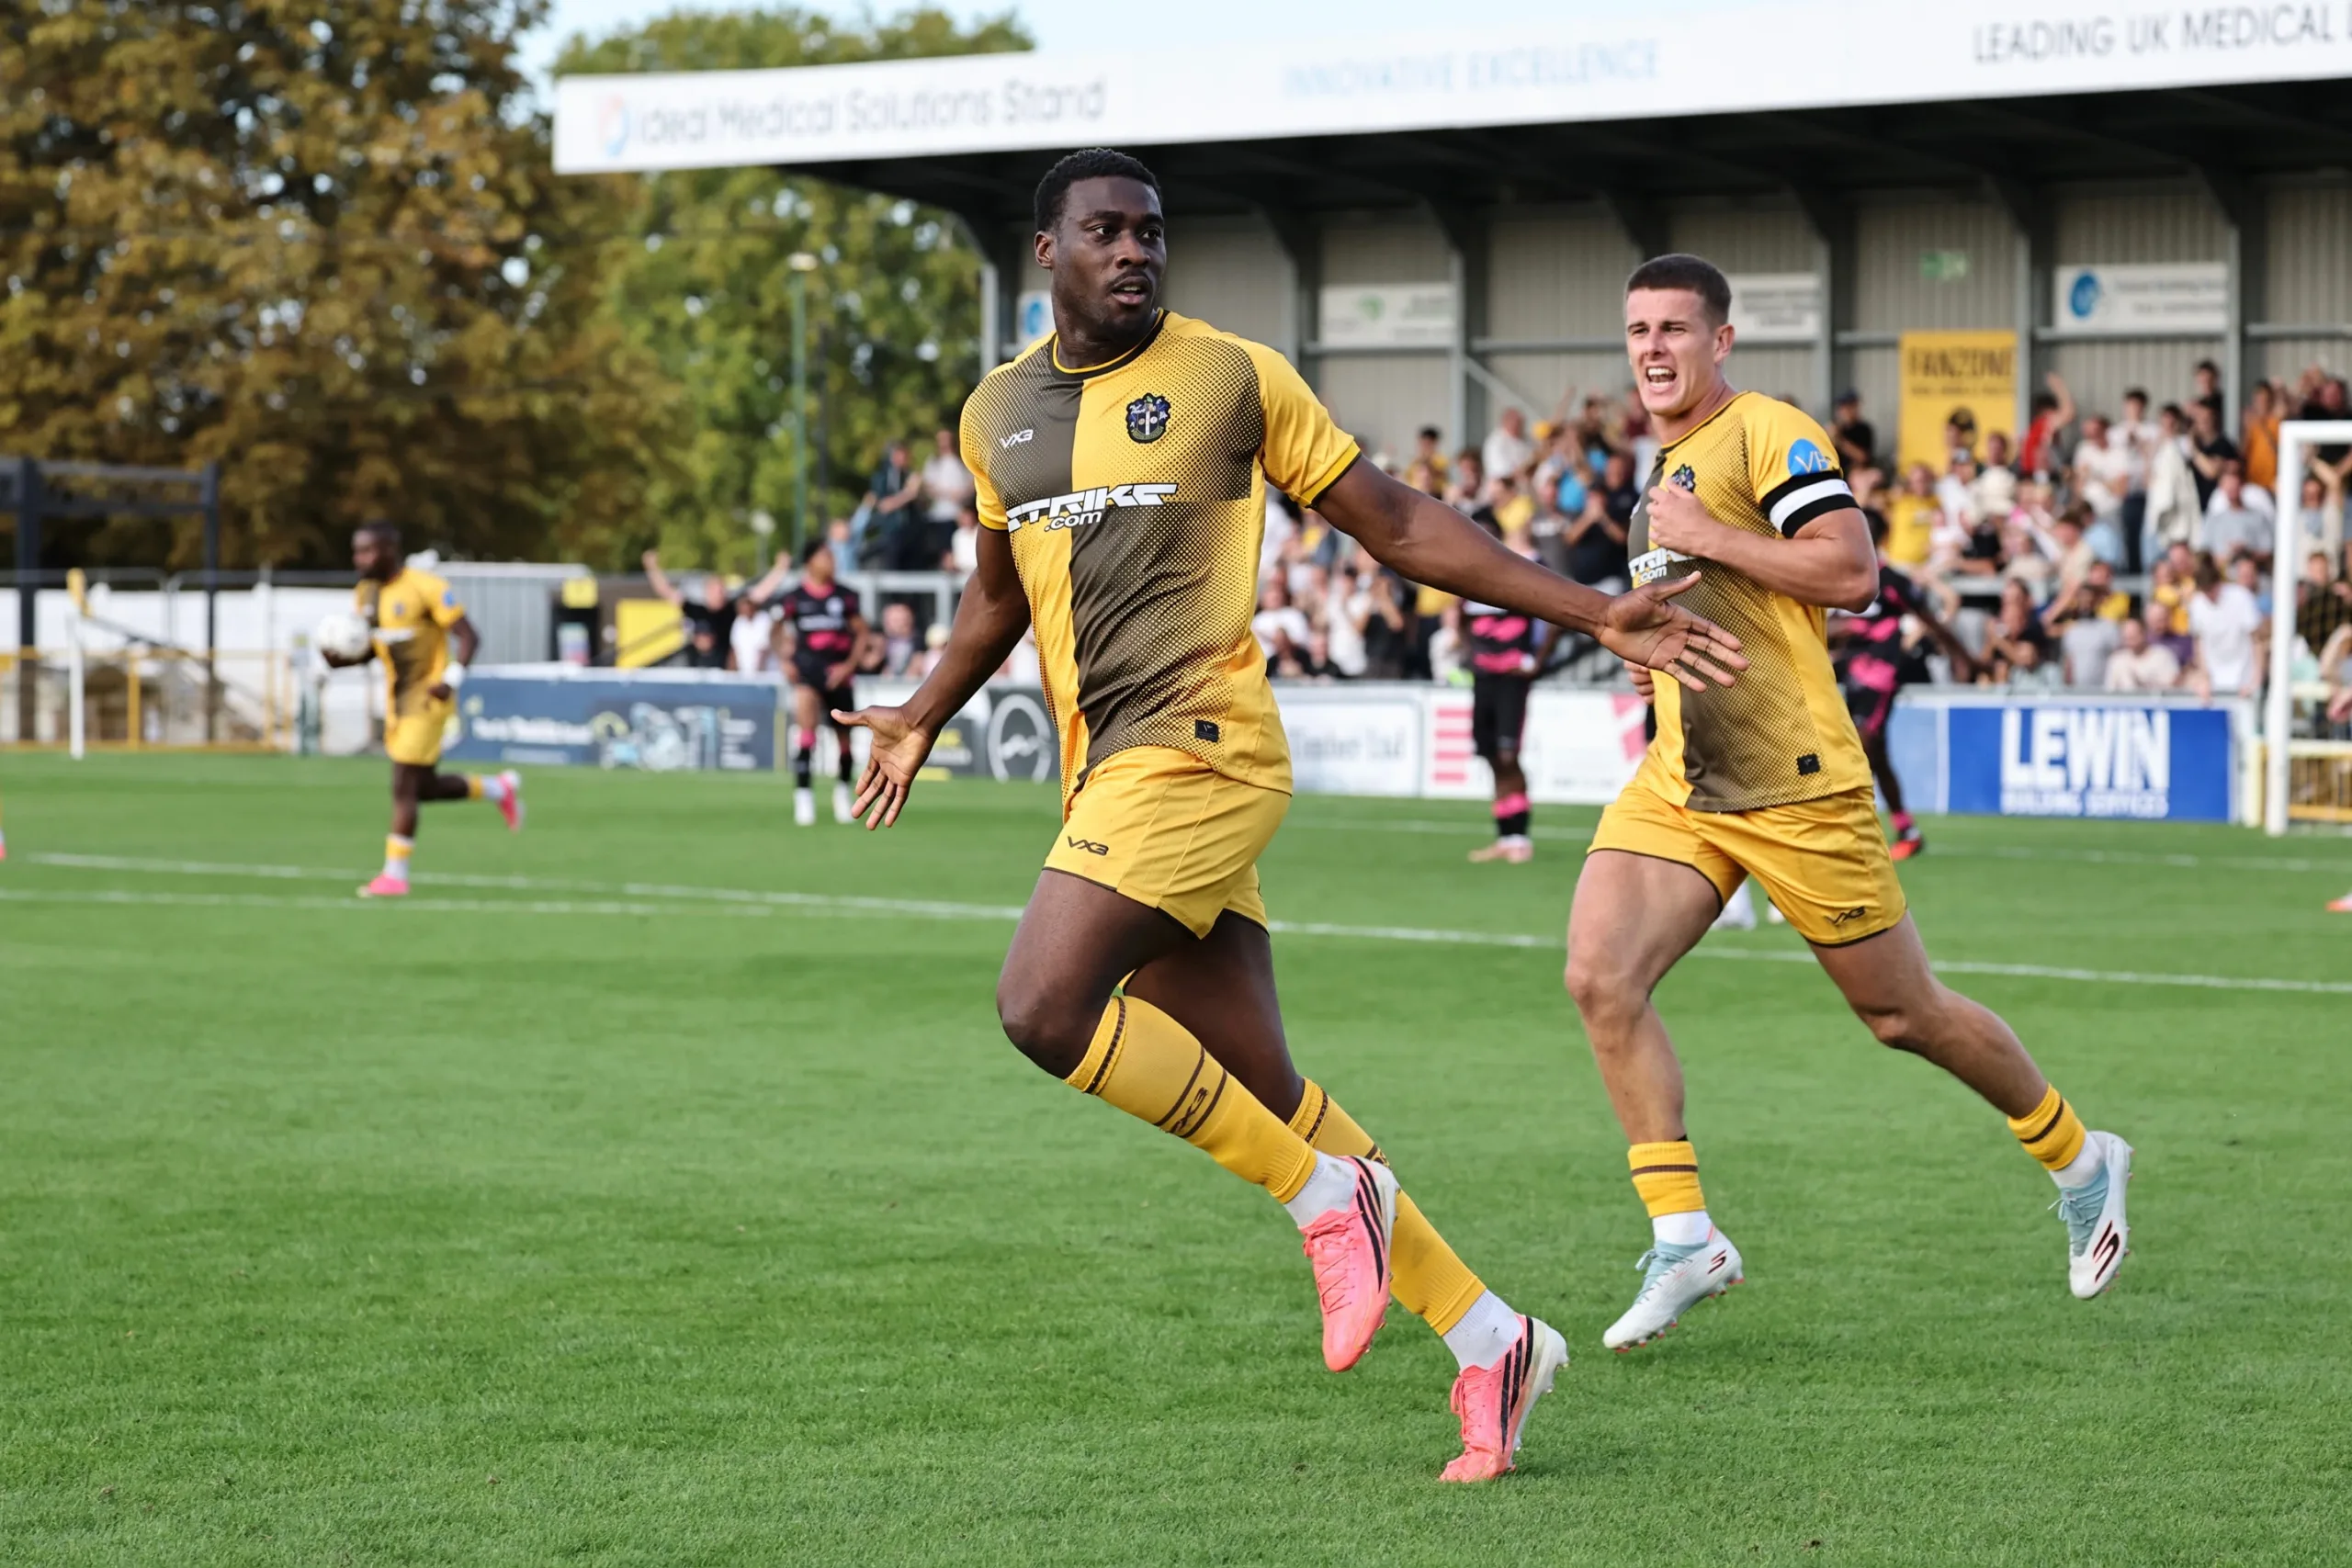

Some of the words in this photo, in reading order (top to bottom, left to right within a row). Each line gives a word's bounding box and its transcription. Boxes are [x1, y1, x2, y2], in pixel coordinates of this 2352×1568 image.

[1973, 17, 2114, 63] LEADING
[2126, 11, 2171, 53] UK
[2181, 4, 2335, 49] MEDICAL
[1283, 54, 1454, 95] INNOVATIVE
[1469, 40, 1659, 87] EXCELLENCE
[718, 91, 835, 141] Medical
[845, 86, 994, 134] Solutions
[1001, 75, 1107, 125] Stand
[1000, 429, 1034, 449] VX3
[1044, 511, 1102, 532] .com
[2001, 708, 2170, 789] LEWIN
[2085, 790, 2169, 818] SERVICES
[1068, 835, 1109, 856] VX3
